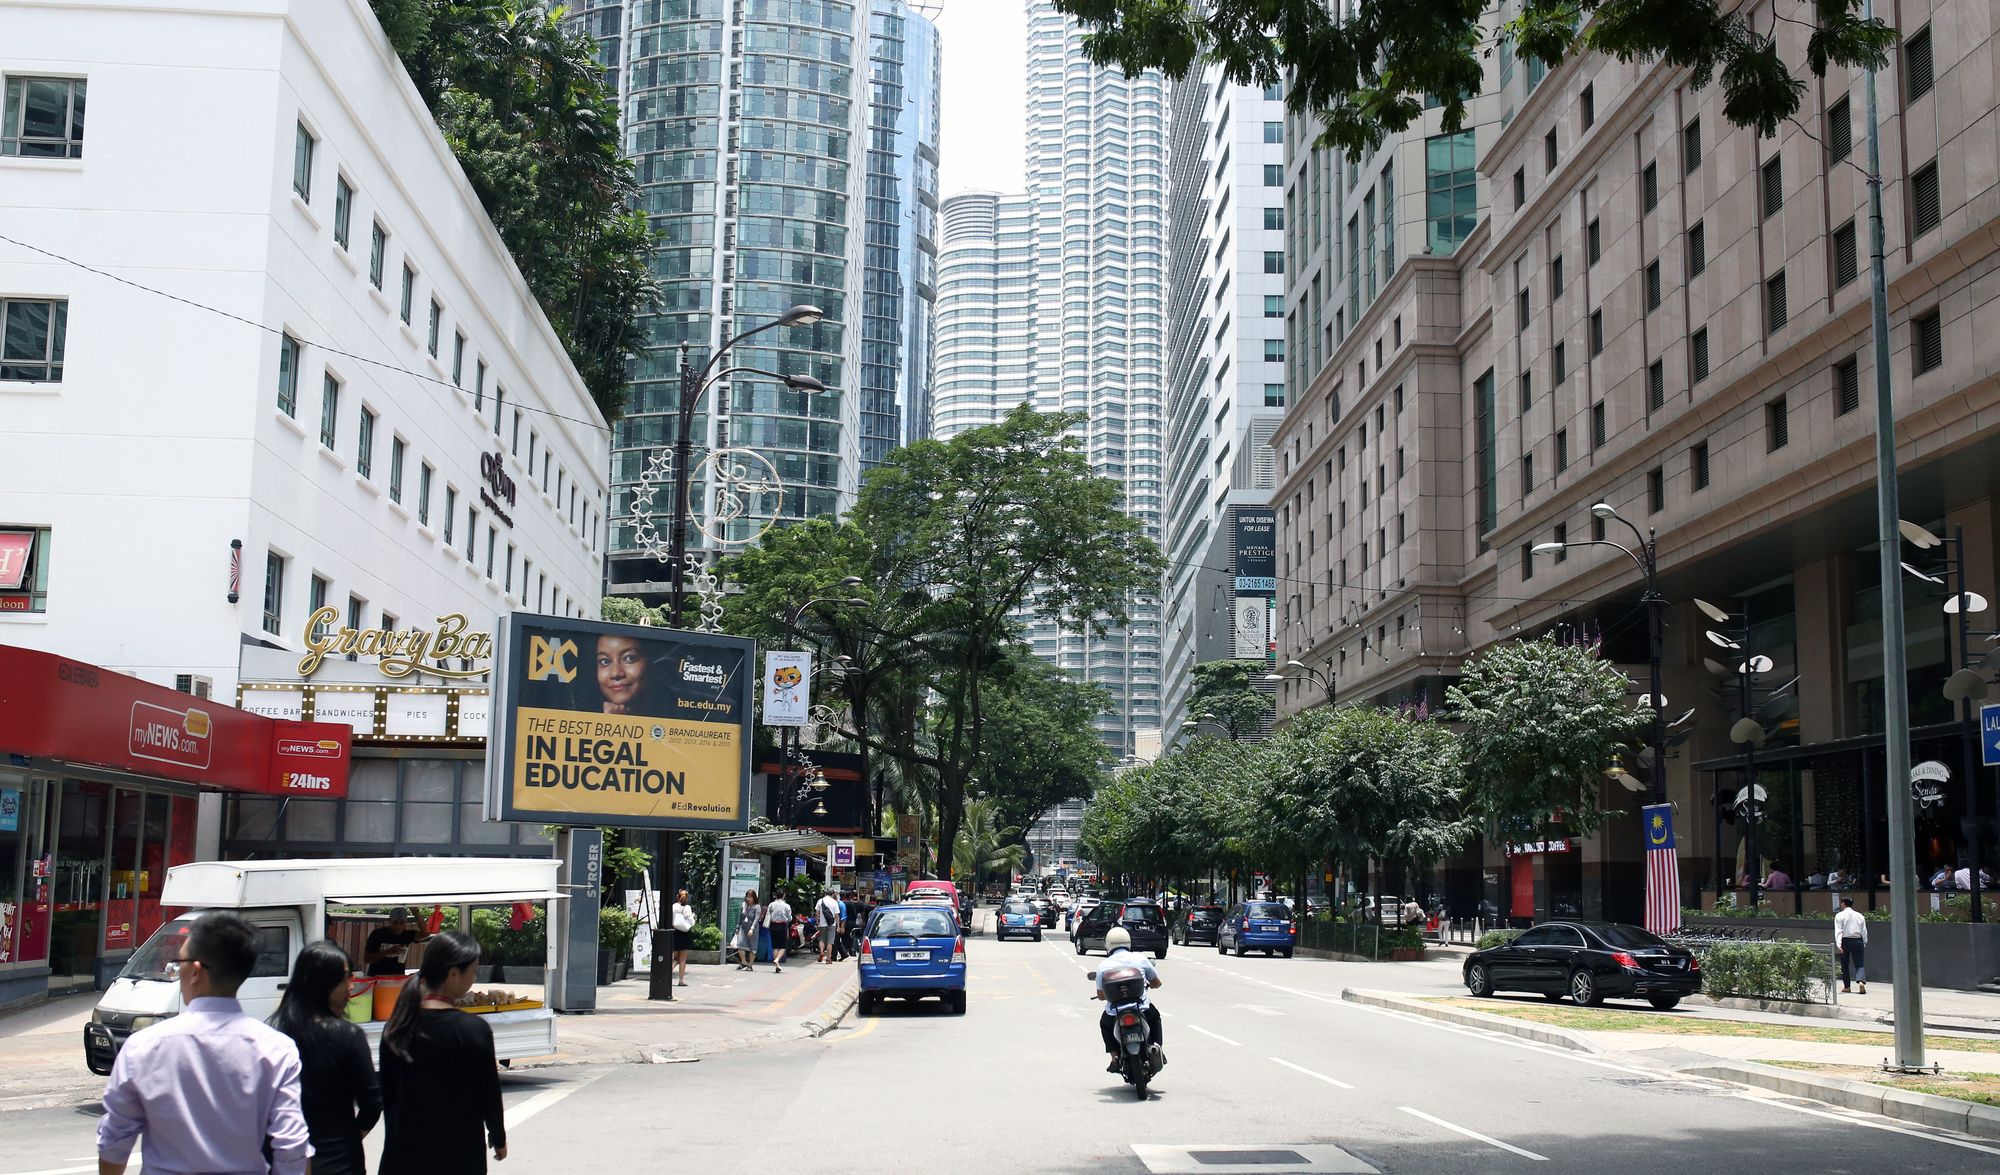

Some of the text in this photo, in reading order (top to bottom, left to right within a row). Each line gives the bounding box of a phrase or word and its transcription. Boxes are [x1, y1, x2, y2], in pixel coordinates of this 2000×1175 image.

[296, 605, 492, 678] Gravy Ba
[527, 635, 579, 684] BAC
[716, 664, 723, 675] &
[283, 707, 300, 716] BAR
[677, 697, 731, 714] bac.edu.my
[315, 709, 374, 718] SANDWICHES
[406, 711, 428, 719] PIES
[528, 717, 644, 739] THE BEST BRAND
[668, 727, 731, 740] BRANDLAUREATE
[526, 735, 648, 767] IN LEGAL
[289, 772, 330, 790] 24hrs
[525, 761, 685, 795] EDUCATION
[671, 801, 731, 814] #EdRevolution
[838, 847, 850, 855] KL
